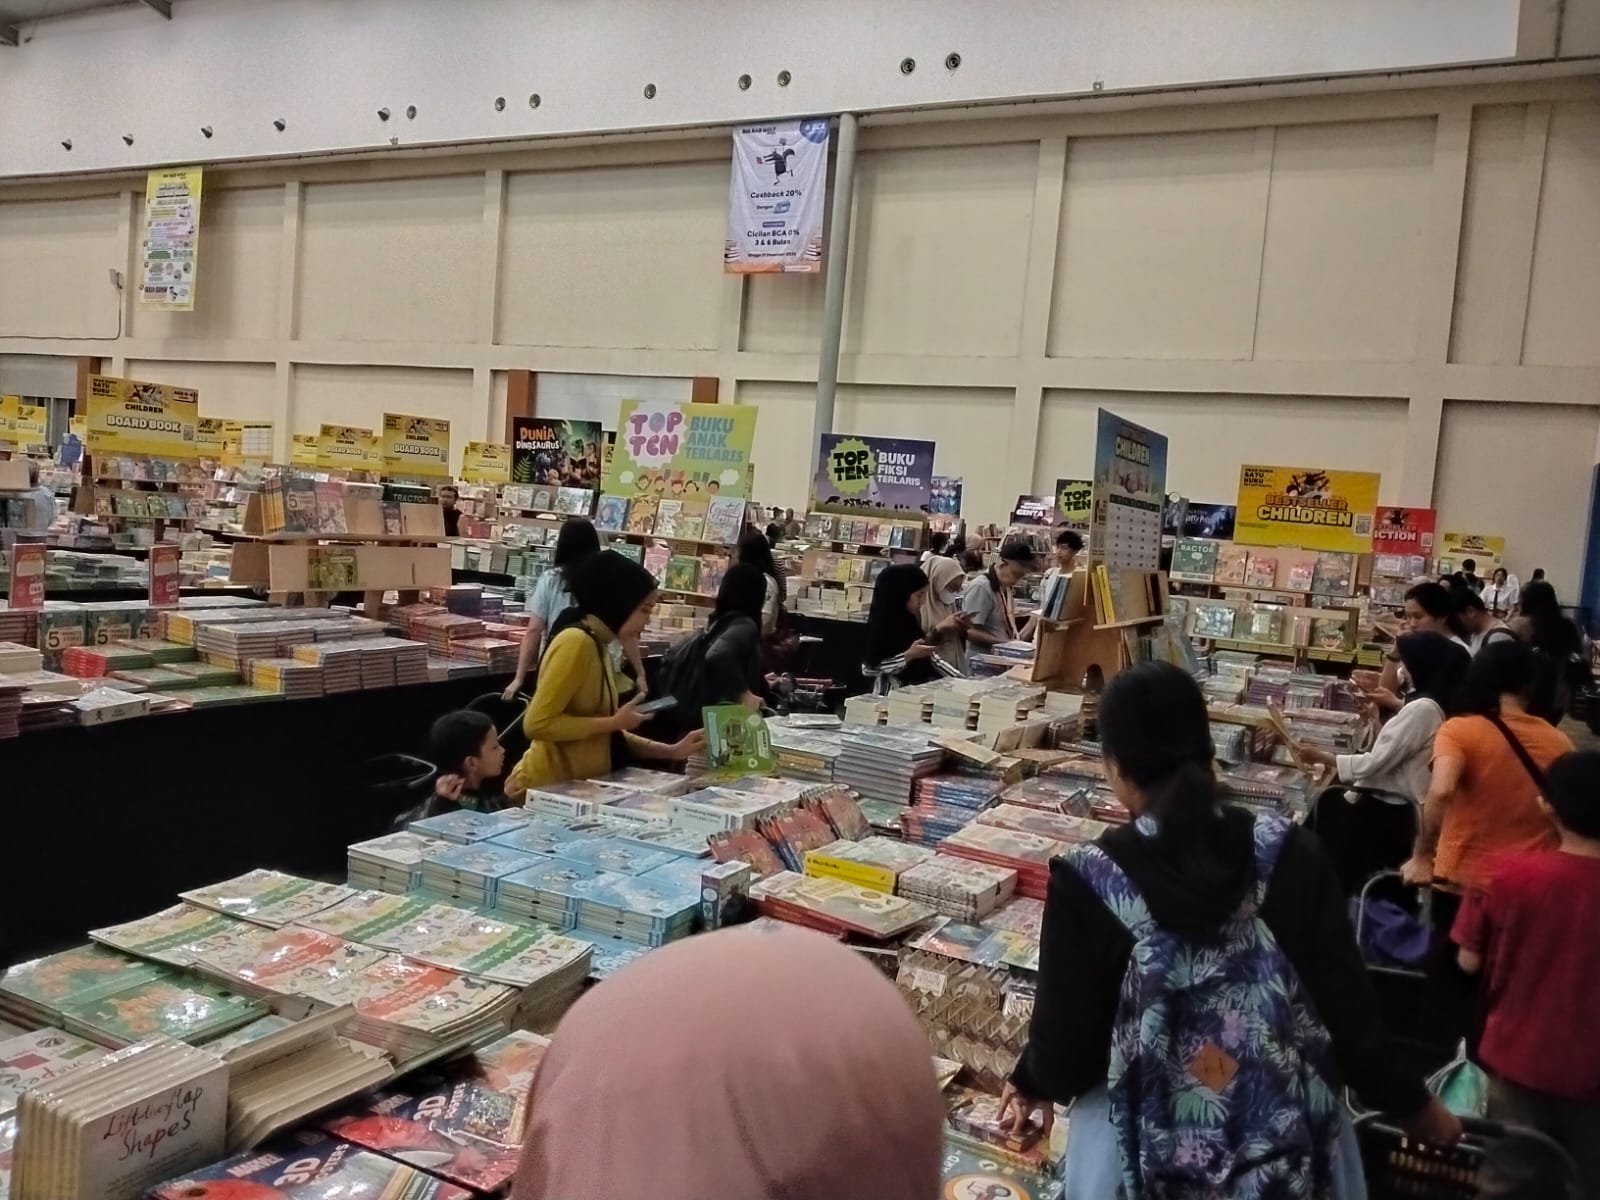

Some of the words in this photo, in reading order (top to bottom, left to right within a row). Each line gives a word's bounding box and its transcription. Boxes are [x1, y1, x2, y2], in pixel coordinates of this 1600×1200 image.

[750, 190, 784, 199] Cashback
[785, 189, 802, 197] 20%
[747, 230, 771, 238] Cicilan
[772, 229, 787, 237] BCA
[772, 238, 791, 246] Bulan
[125, 403, 164, 414] CHILDREN
[106, 414, 148, 429] BOARD
[148, 419, 182, 433] BOOK
[628, 411, 684, 435] TOP
[689, 415, 735, 434] BUKU
[519, 425, 555, 441] DUNIA
[688, 431, 727, 449] ANAK
[628, 433, 680, 457] TEN
[1115, 435, 1150, 465] CHILDREN
[685, 447, 744, 464] TERLARIS
[833, 449, 869, 467] TOP
[877, 452, 916, 466] BUKU
[834, 464, 870, 482] TEN
[877, 465, 907, 477] FIKSI
[877, 475, 921, 487] TERLARIS
[289, 494, 298, 509] 5
[1064, 489, 1092, 501] TOP
[1265, 494, 1348, 511] BESTSELLER
[1064, 499, 1092, 512] TEN
[1257, 504, 1353, 527] CHILDREN
[1373, 529, 1417, 541] ICTION
[48, 631, 60, 647] 5
[97, 628, 108, 645] 5
[140, 626, 150, 639] 5
[118, 1110, 192, 1162] Shapes
[227, 1153, 284, 1178] MARVEL
[274, 1156, 321, 1187] 3D
